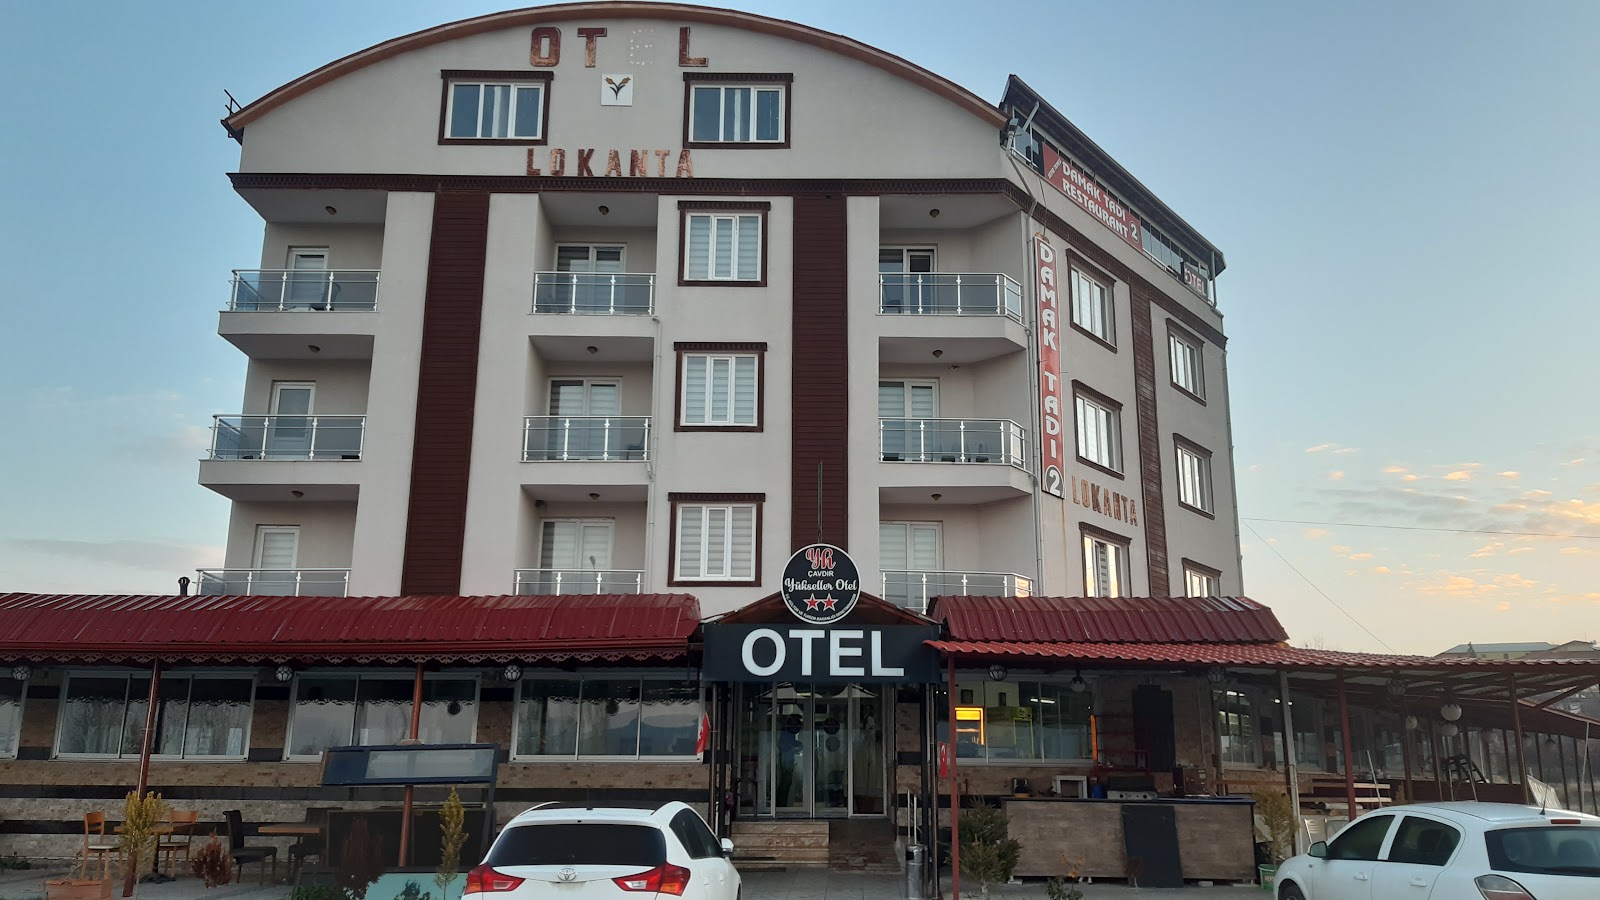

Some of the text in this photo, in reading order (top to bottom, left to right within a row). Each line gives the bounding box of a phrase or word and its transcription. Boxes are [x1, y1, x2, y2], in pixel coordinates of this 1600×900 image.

[526, 147, 694, 178] LOKANTA
[1062, 161, 1101, 202] DAMAK
[1103, 194, 1127, 222] TADI
[1062, 178, 1128, 238] RESTAURANT
[1130, 223, 1139, 241] 2
[1040, 242, 1061, 497] DAMAK TADI 2
[1071, 475, 1138, 526] LOKANTA
[784, 577, 857, 592] Yükseller Otel
[808, 570, 834, 578] ÇAVDIR
[741, 628, 904, 676] OTEL
